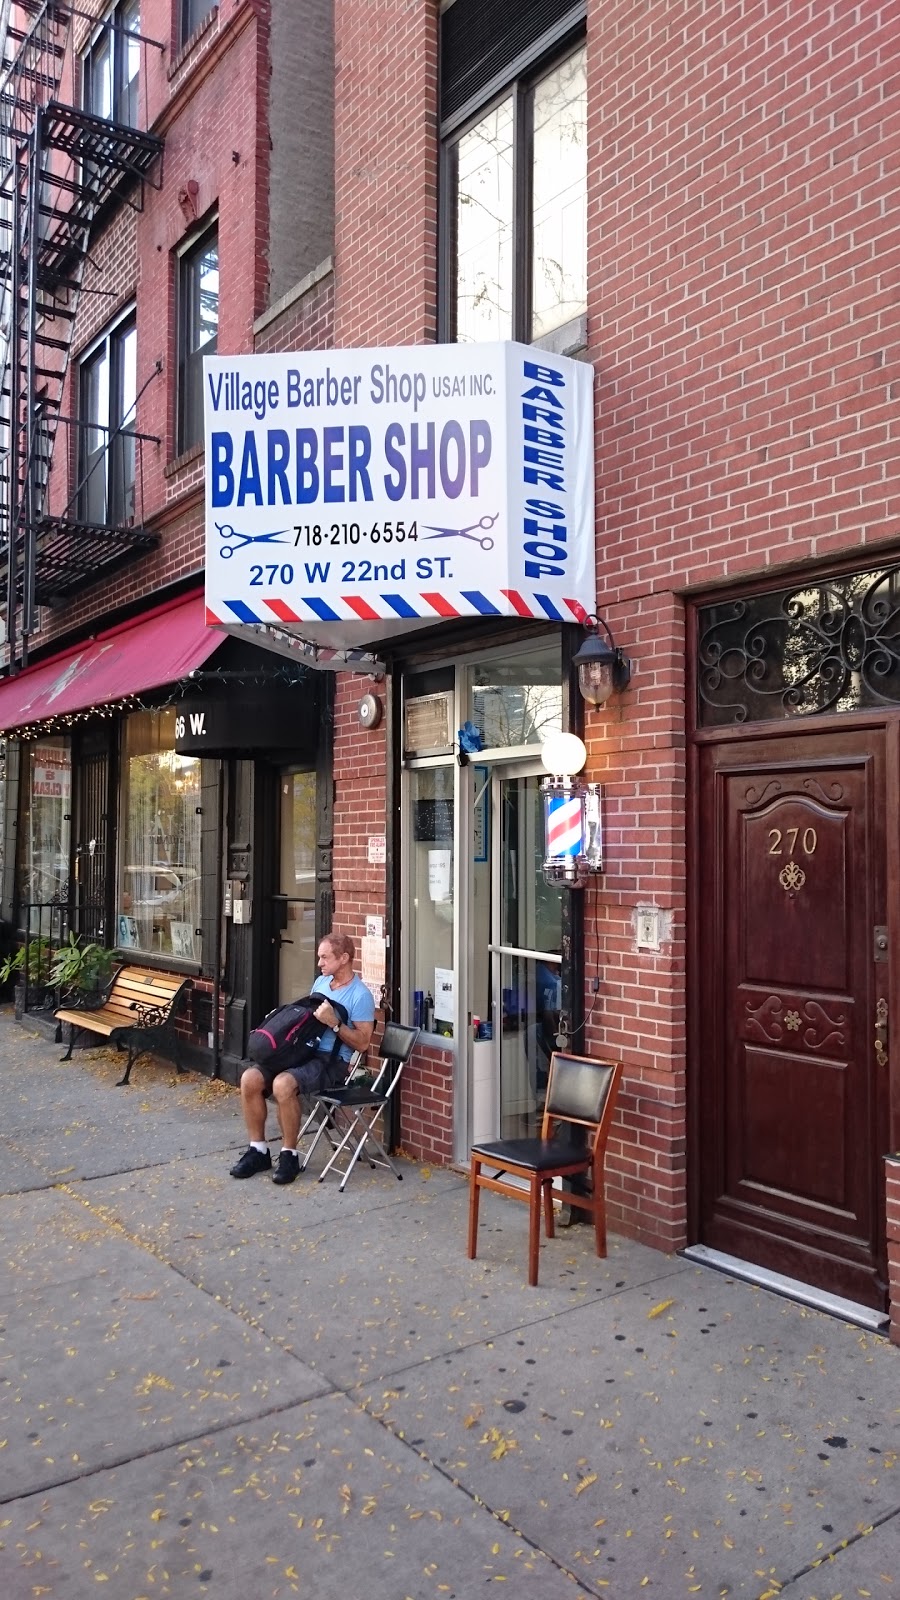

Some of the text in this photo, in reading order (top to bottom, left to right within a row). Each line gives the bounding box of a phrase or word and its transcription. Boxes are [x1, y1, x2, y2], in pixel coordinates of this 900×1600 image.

[208, 364, 496, 420] Village Barber Shop USA1 INC.
[211, 419, 492, 508] BARBER SHOP
[521, 361, 567, 579] BARBER SHOP
[249, 557, 454, 586] 270 W 22nd ST.
[190, 712, 207, 736] W.
[768, 827, 817, 855] 270
